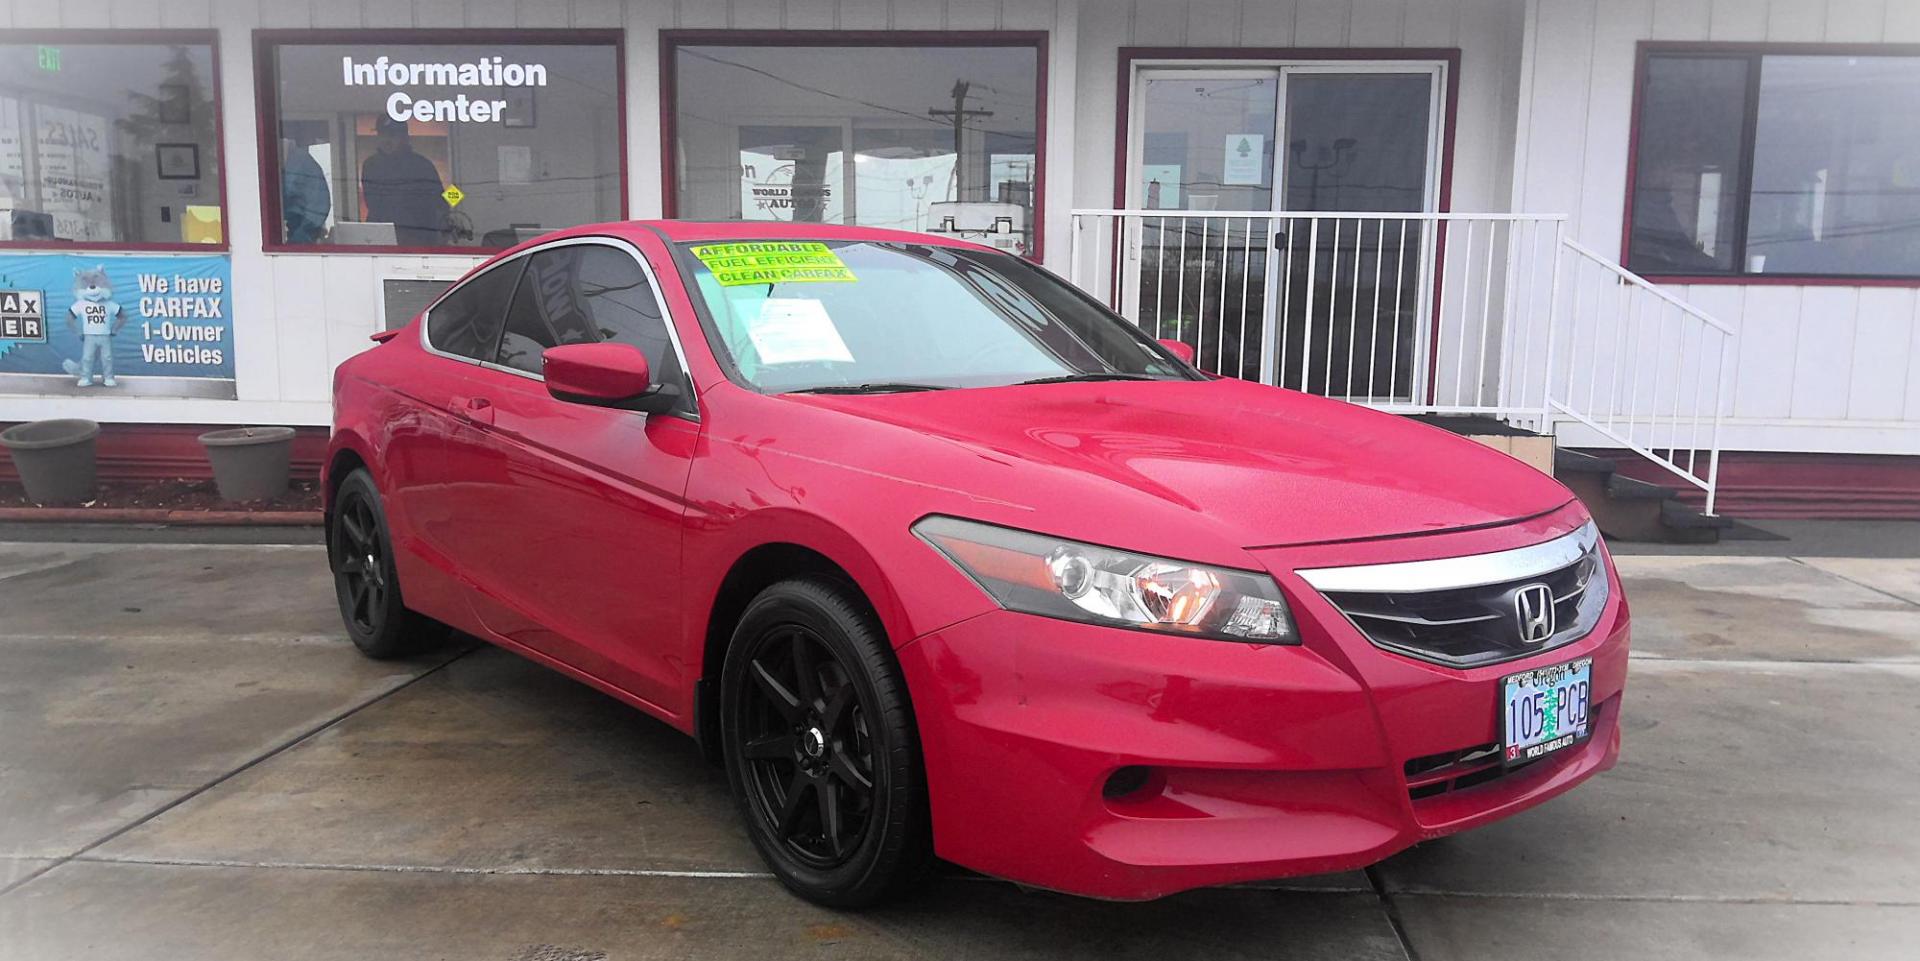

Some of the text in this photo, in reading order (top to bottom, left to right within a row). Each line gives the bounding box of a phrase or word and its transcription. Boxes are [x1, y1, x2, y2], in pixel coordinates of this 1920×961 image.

[38, 47, 61, 72] EXIT
[343, 56, 547, 87] Information
[386, 91, 507, 123] Center
[752, 188, 788, 197] WORLD
[699, 242, 826, 257] AFFORDABLE
[709, 255, 838, 270] FUEL EFFICIENT
[138, 273, 223, 294] We have
[719, 268, 848, 283] CLEAN CARFAX
[85, 305, 107, 315] CAR
[139, 297, 223, 318] CARFAX
[87, 315, 107, 325] FOX
[141, 321, 224, 342] 1-Owner
[142, 344, 223, 365] Vehicles
[1510, 681, 1588, 743] 105 PCB
[1526, 734, 1573, 759] WORLD FAMOUS AUTO
